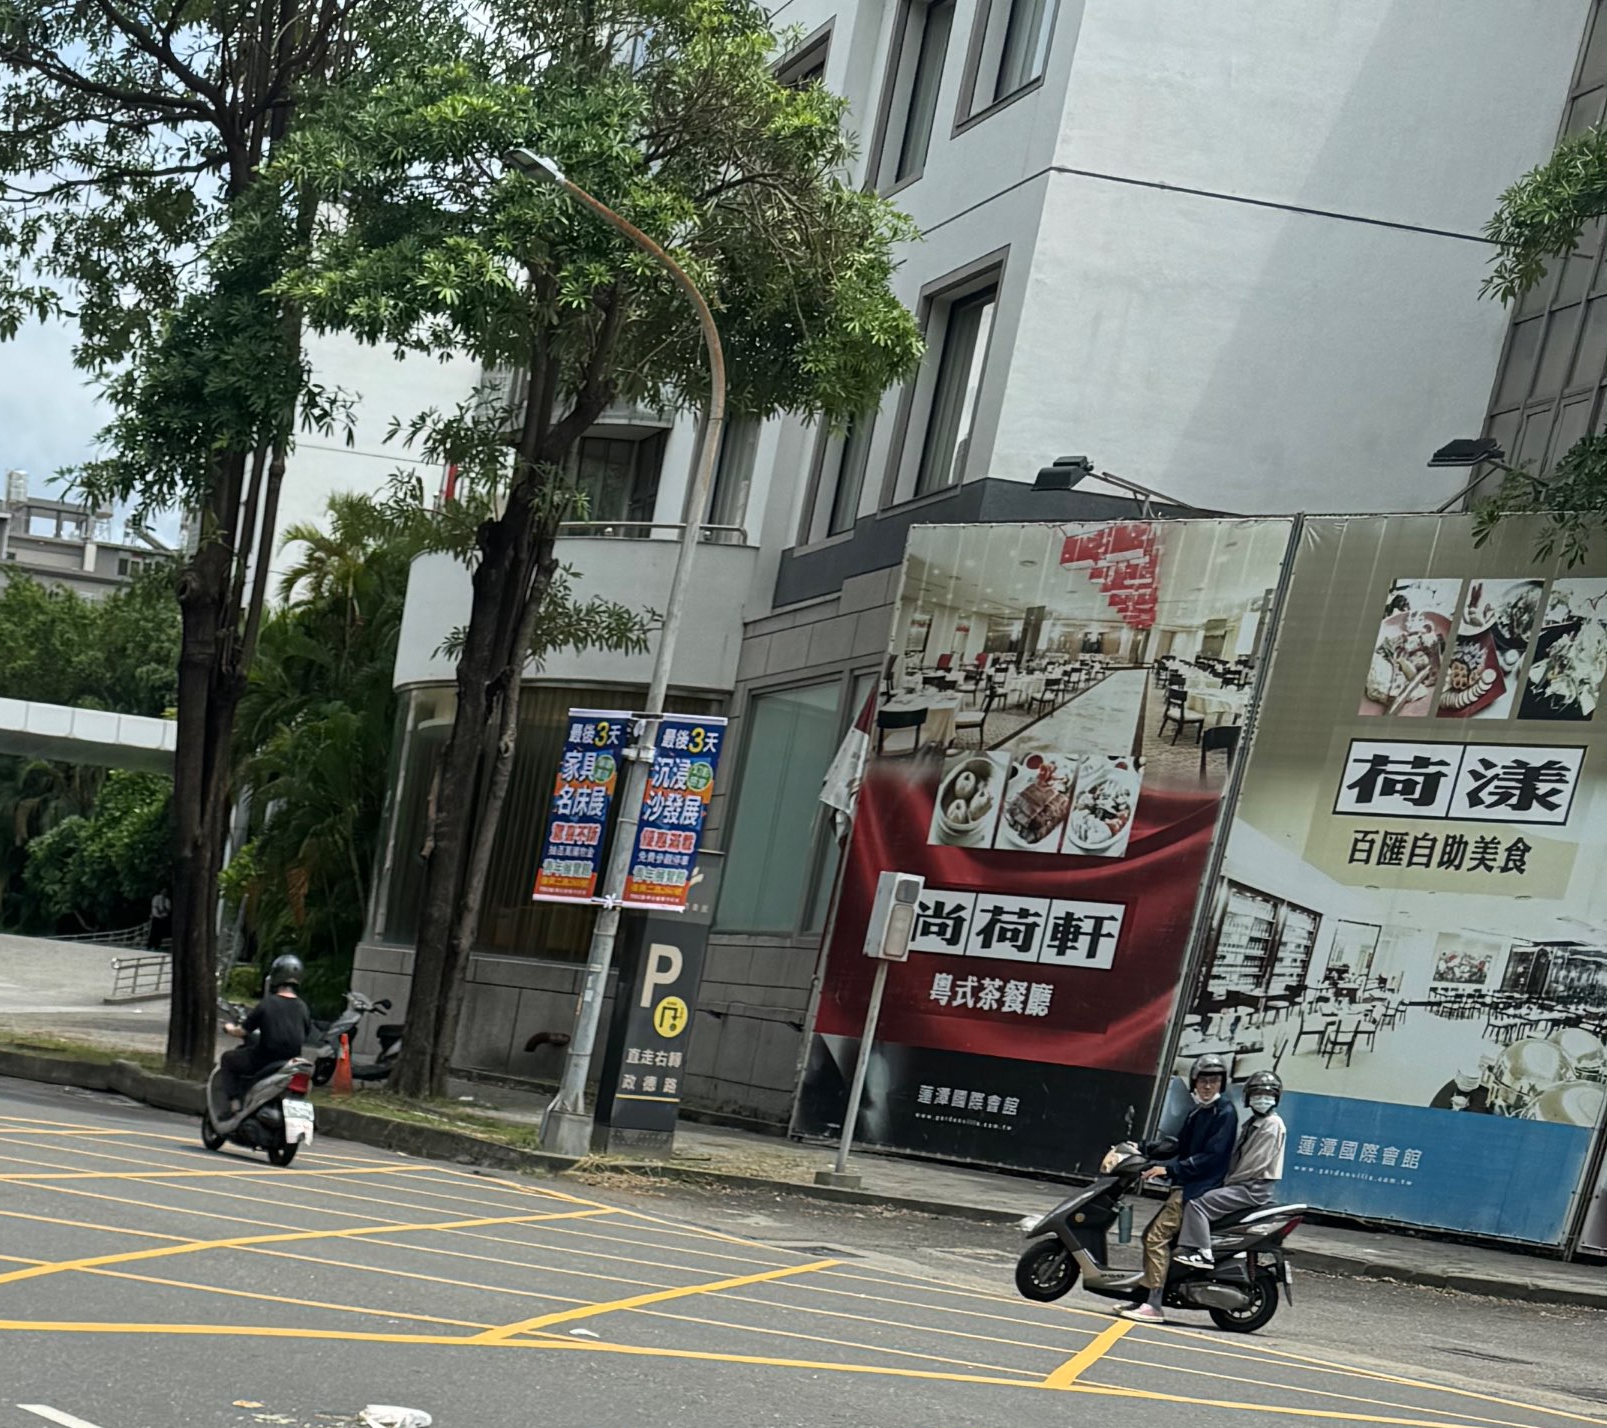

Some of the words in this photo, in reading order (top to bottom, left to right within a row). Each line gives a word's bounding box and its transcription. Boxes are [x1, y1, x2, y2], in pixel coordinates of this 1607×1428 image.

[568, 722, 621, 747] 最後3天
[661, 728, 719, 753] 最後3天
[562, 751, 596, 782] 家具
[652, 757, 691, 790] 沉浸
[1347, 754, 1571, 812] 荷漾
[556, 787, 606, 817] 名床展
[644, 791, 702, 826] 沙發展
[1347, 830, 1532, 875] 百匯自助美食
[911, 900, 1119, 959] 尚荷軒
[640, 943, 683, 1008] P
[626, 1048, 683, 1068] 直走右轉
[1297, 1135, 1423, 1169] 蓮潭國際會館
